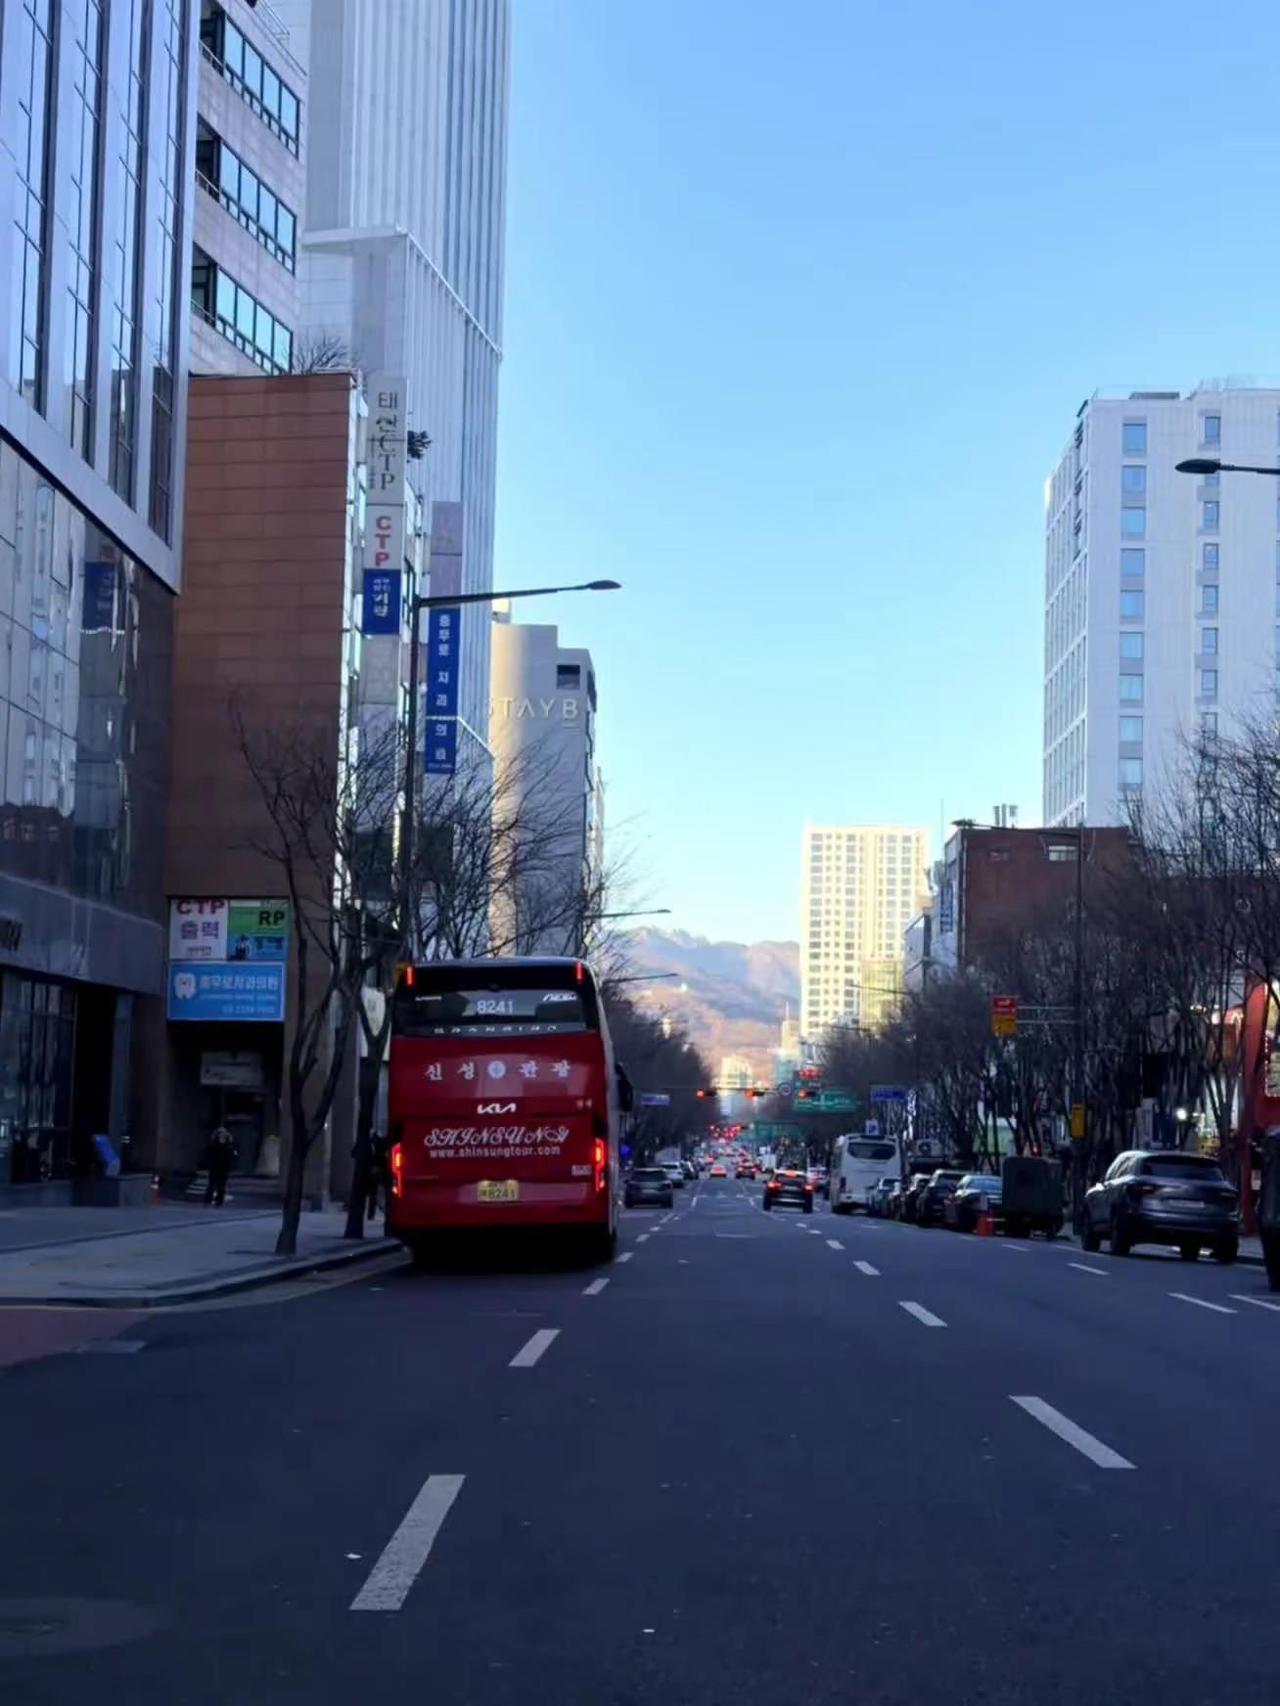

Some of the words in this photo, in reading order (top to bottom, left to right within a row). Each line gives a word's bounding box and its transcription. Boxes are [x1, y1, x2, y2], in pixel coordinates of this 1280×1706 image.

[374, 515, 392, 567] CTP
[177, 899, 225, 915] CTP
[259, 910, 286, 926] RP
[477, 1000, 514, 1015] 8241
[424, 1125, 570, 1147] SHINSUNG
[429, 1144, 561, 1159] www.shinsungtour.com
